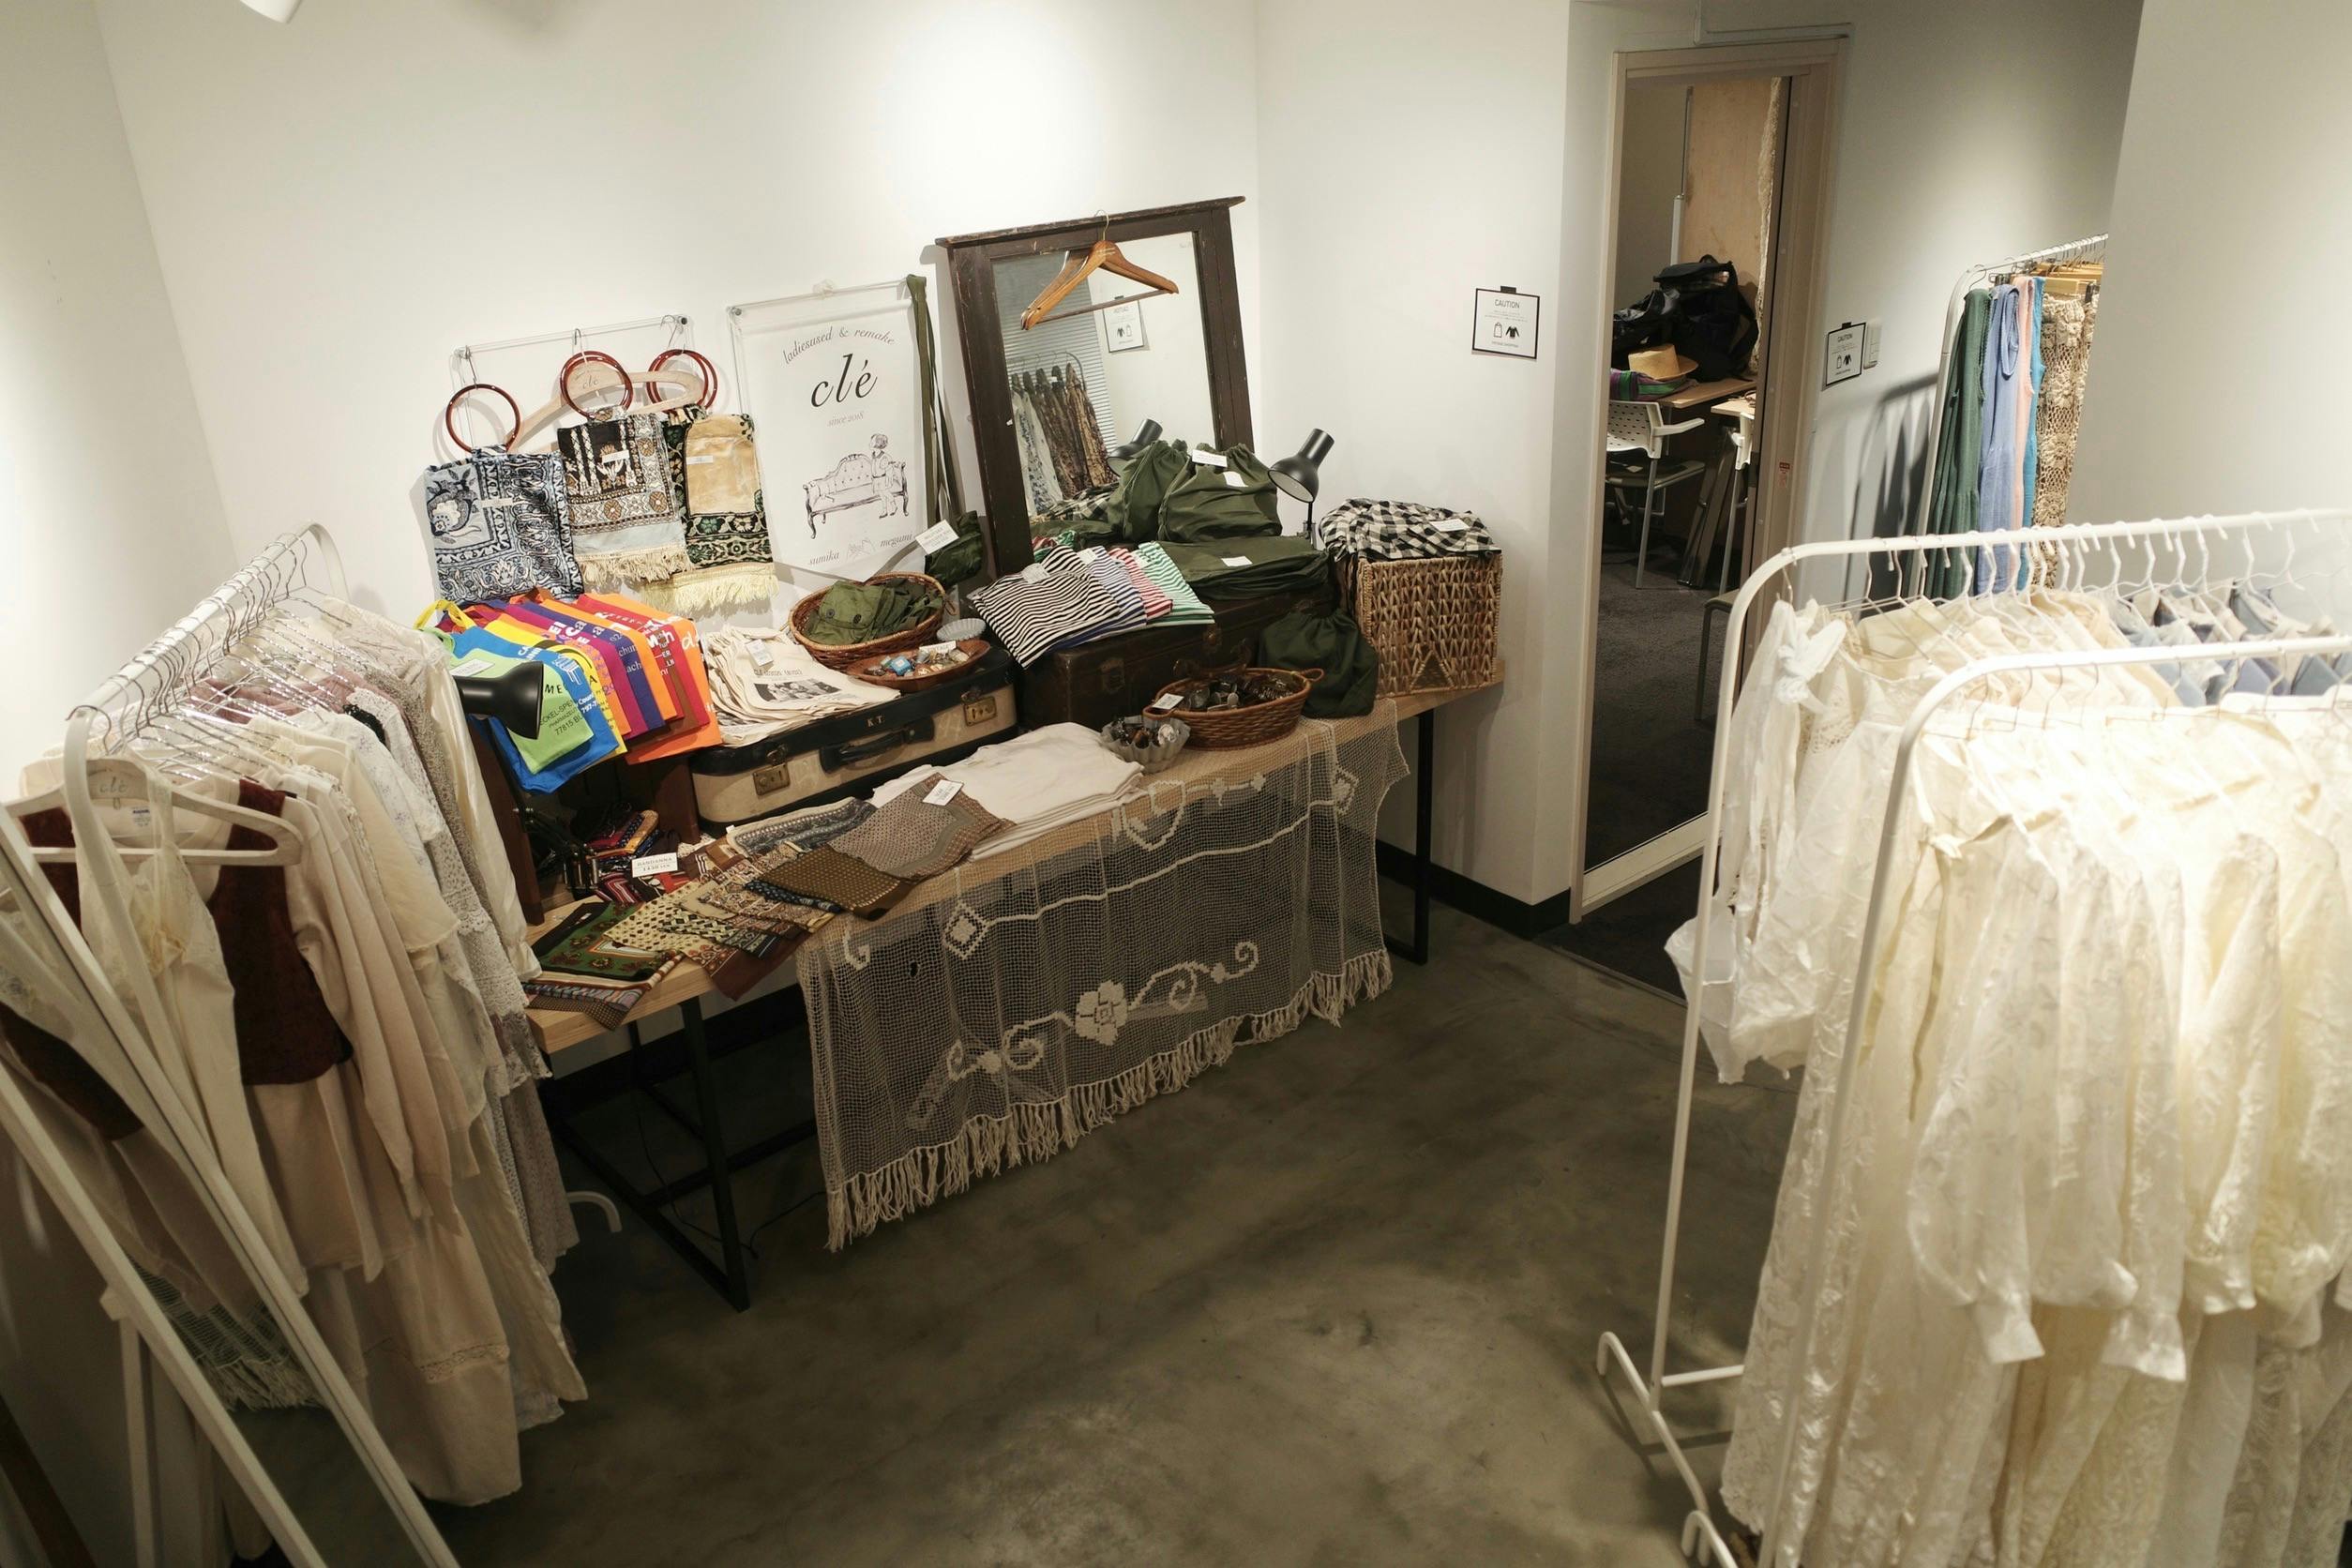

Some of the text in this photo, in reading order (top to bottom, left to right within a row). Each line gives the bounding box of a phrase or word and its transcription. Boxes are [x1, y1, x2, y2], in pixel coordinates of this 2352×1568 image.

[1495, 299, 1520, 309] CAUTION
[854, 328, 895, 345] remake
[810, 353, 878, 408] clé
[827, 415, 847, 426] since
[880, 533, 912, 548] megumi
[809, 550, 839, 565] sumika
